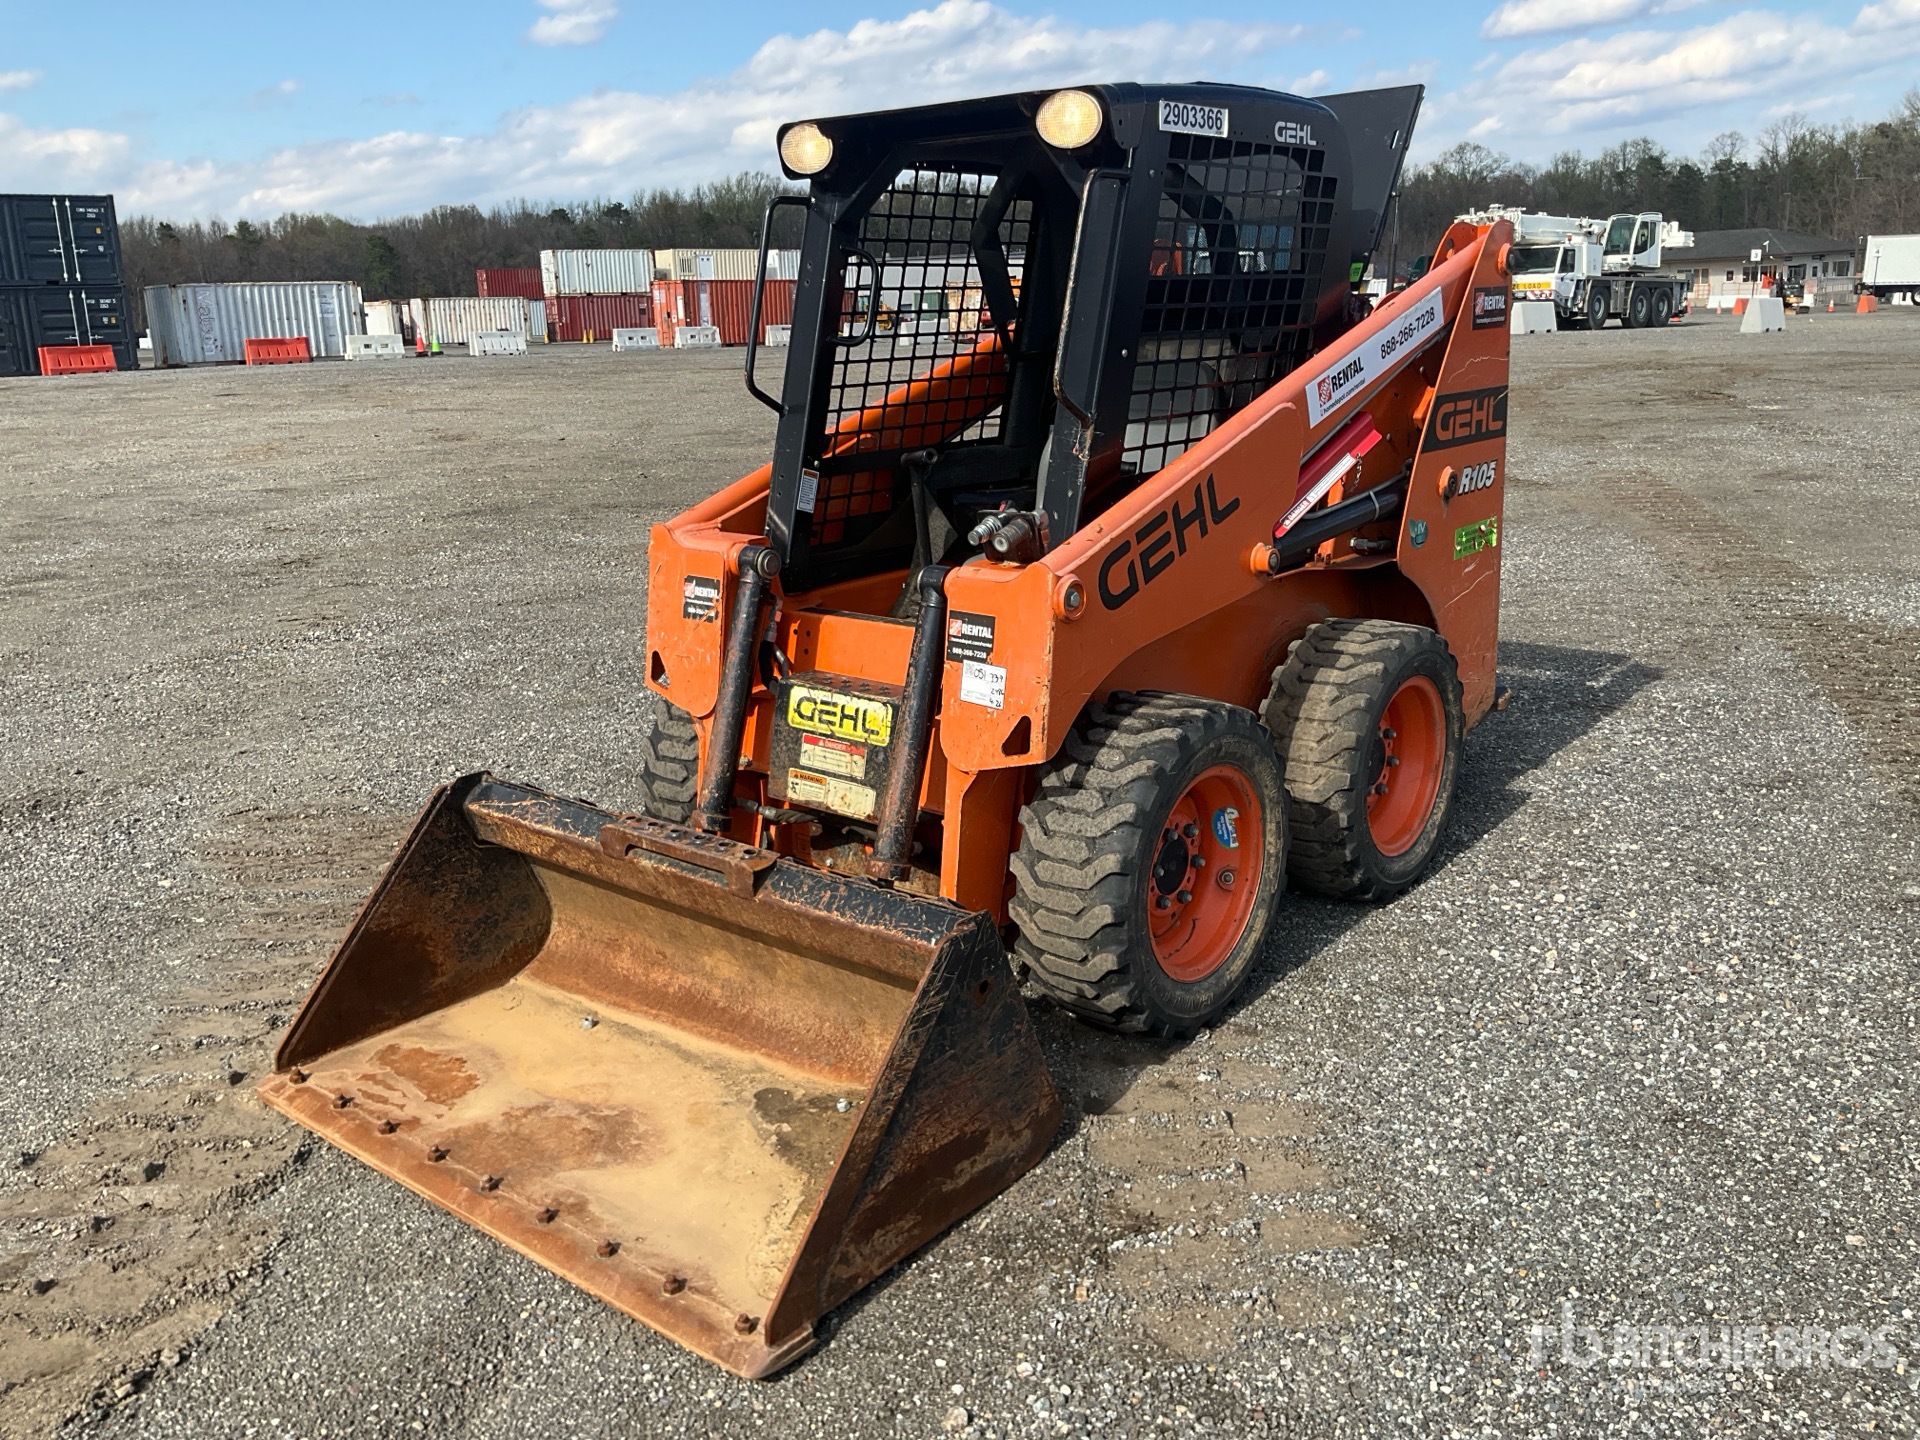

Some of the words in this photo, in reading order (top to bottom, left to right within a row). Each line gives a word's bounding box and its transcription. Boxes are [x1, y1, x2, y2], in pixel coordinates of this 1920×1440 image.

[1163, 102, 1223, 131] 2903366
[1274, 121, 1317, 146] GEHL
[1484, 295, 1505, 310] RENTAL
[196, 287, 216, 355] Matson
[1380, 306, 1435, 360] 888-266-7228
[1331, 356, 1365, 393] RENTAL
[1435, 396, 1503, 441] GEHL
[1458, 460, 1498, 495] R105
[1288, 500, 1308, 521] DANGER
[1098, 473, 1240, 611] GEHL
[695, 586, 719, 599] RENTAL
[961, 624, 993, 638] RENTAL
[796, 696, 880, 736] GEHL
[825, 740, 846, 753] DANGER
[799, 773, 823, 785] WARNING
